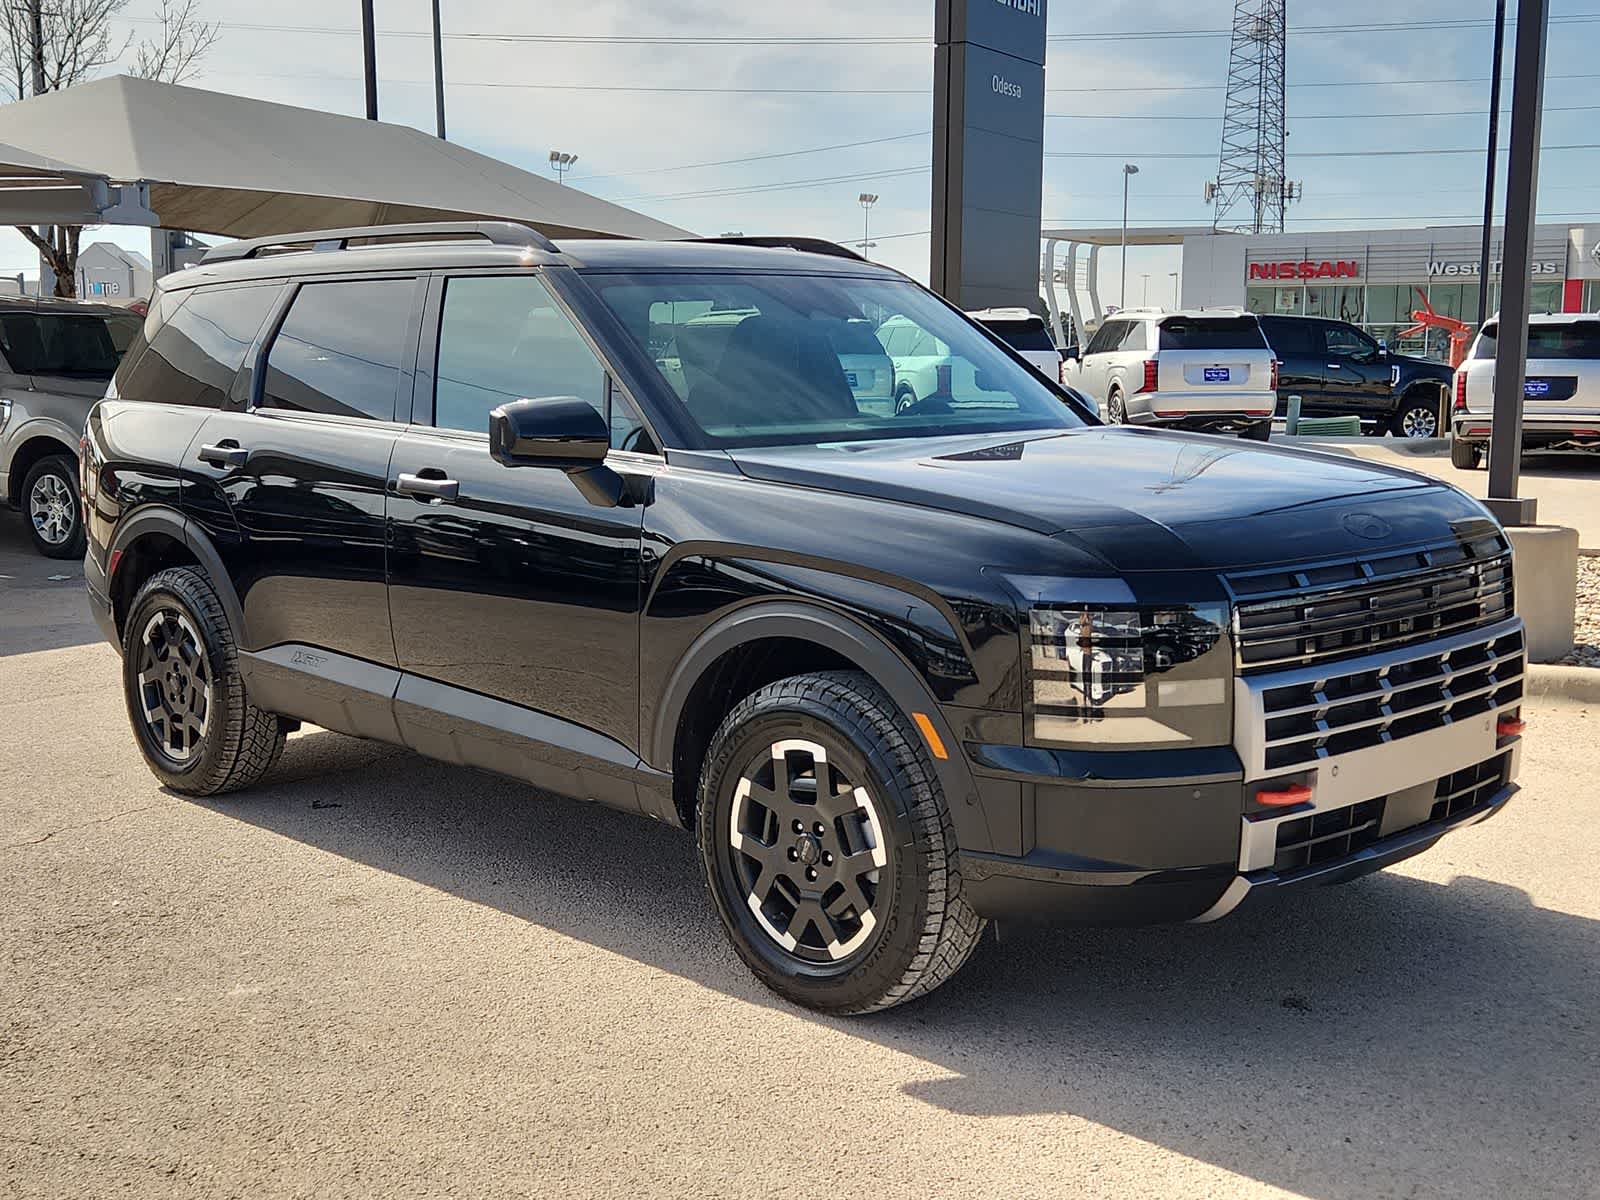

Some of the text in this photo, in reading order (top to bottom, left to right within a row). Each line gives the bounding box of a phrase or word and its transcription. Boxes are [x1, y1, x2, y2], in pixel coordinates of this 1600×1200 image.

[992, 75, 1022, 98] Odessa
[1248, 260, 1357, 280] NISSAN
[1425, 260, 1556, 276] West Tas
